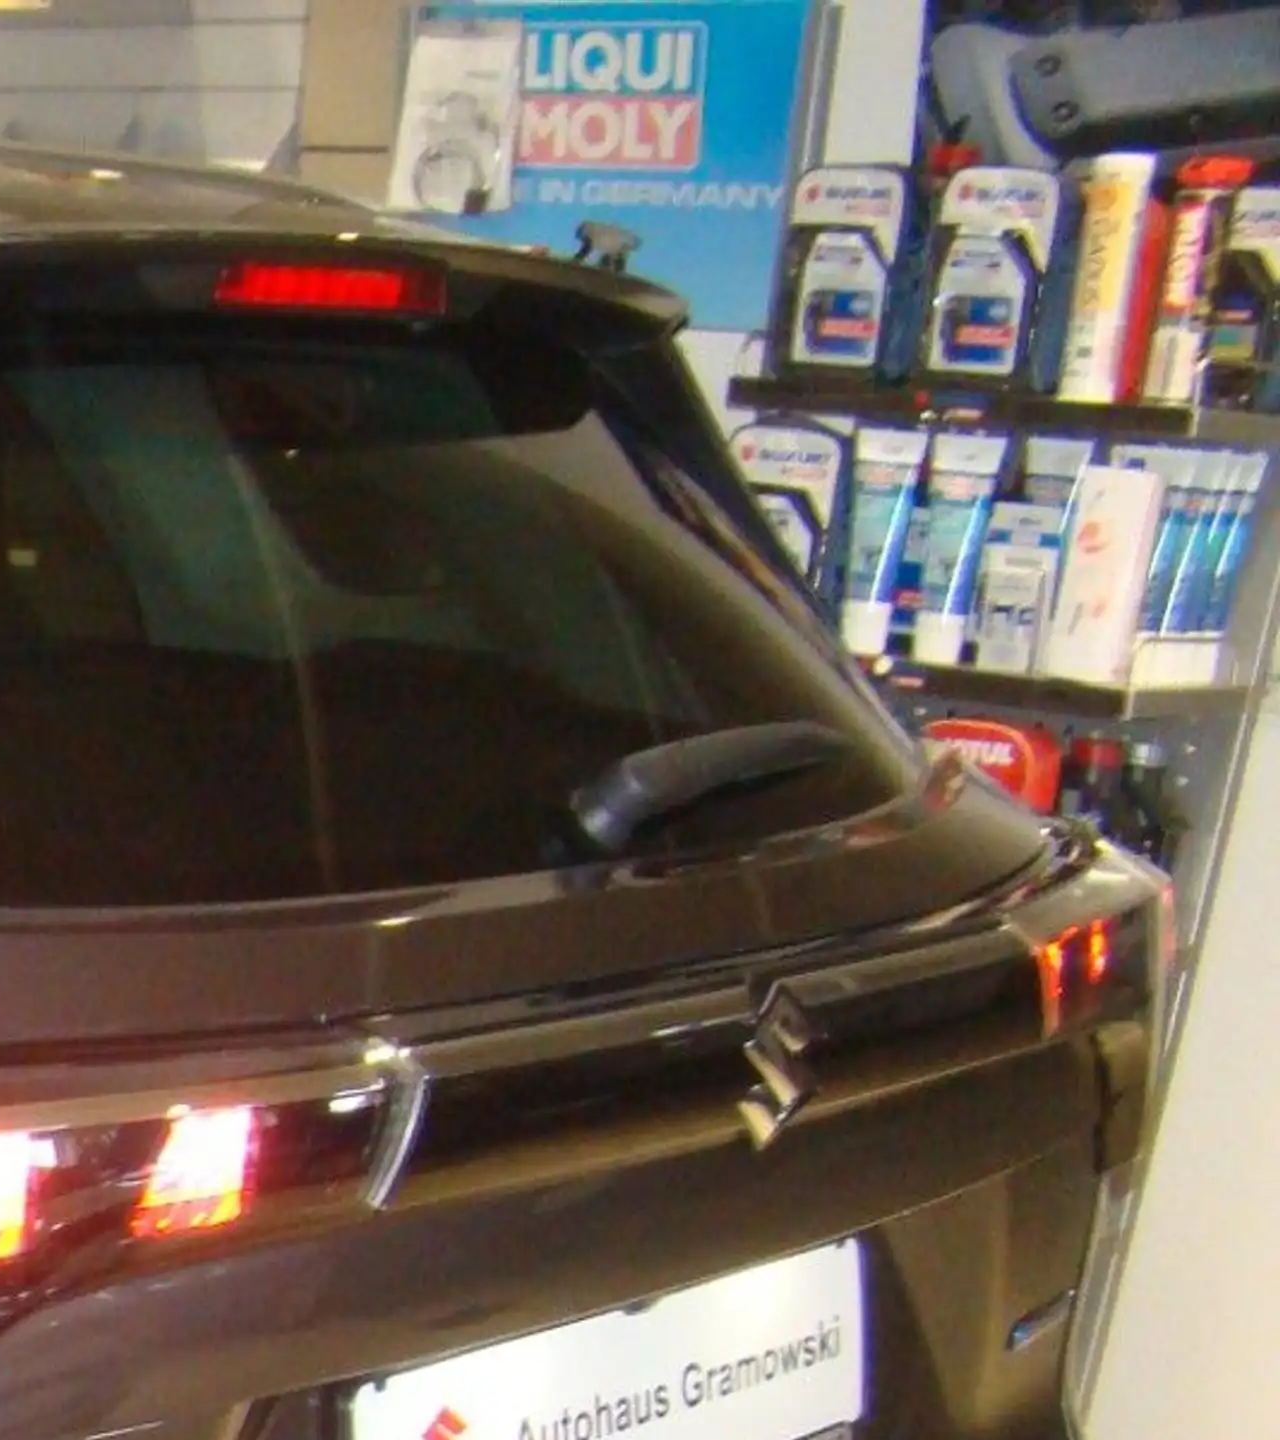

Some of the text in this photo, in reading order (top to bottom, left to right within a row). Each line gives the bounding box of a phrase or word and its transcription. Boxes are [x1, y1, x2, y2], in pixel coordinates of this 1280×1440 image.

[525, 31, 694, 93] LIQUI
[520, 101, 694, 160] MOLY
[682, 1317, 841, 1407] Gramowski
